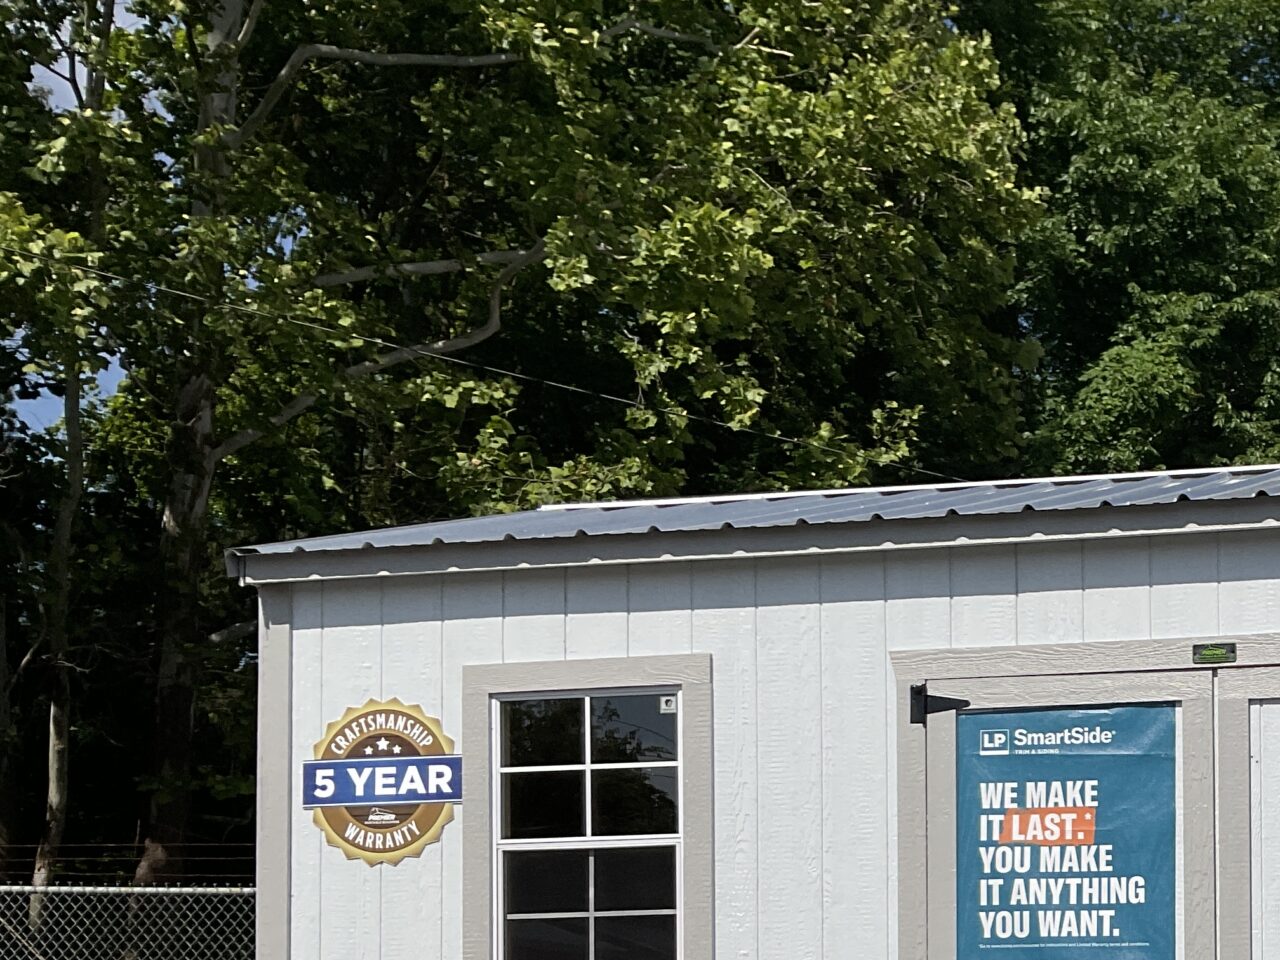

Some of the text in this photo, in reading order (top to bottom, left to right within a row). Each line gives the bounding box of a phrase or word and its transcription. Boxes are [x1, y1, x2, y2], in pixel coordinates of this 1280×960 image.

[330, 713, 434, 755] CRAFTSMANSHIP
[983, 733, 1006, 748] LP
[313, 764, 453, 798] 5 YEAR
[979, 780, 1099, 809] WE MAKE
[344, 820, 421, 849] WARRANTY
[979, 814, 1005, 841] IT
[979, 845, 1113, 873] YOU MAKE
[979, 876, 1146, 906] IT ANYTHING
[979, 910, 1120, 938] YOU WANT.
